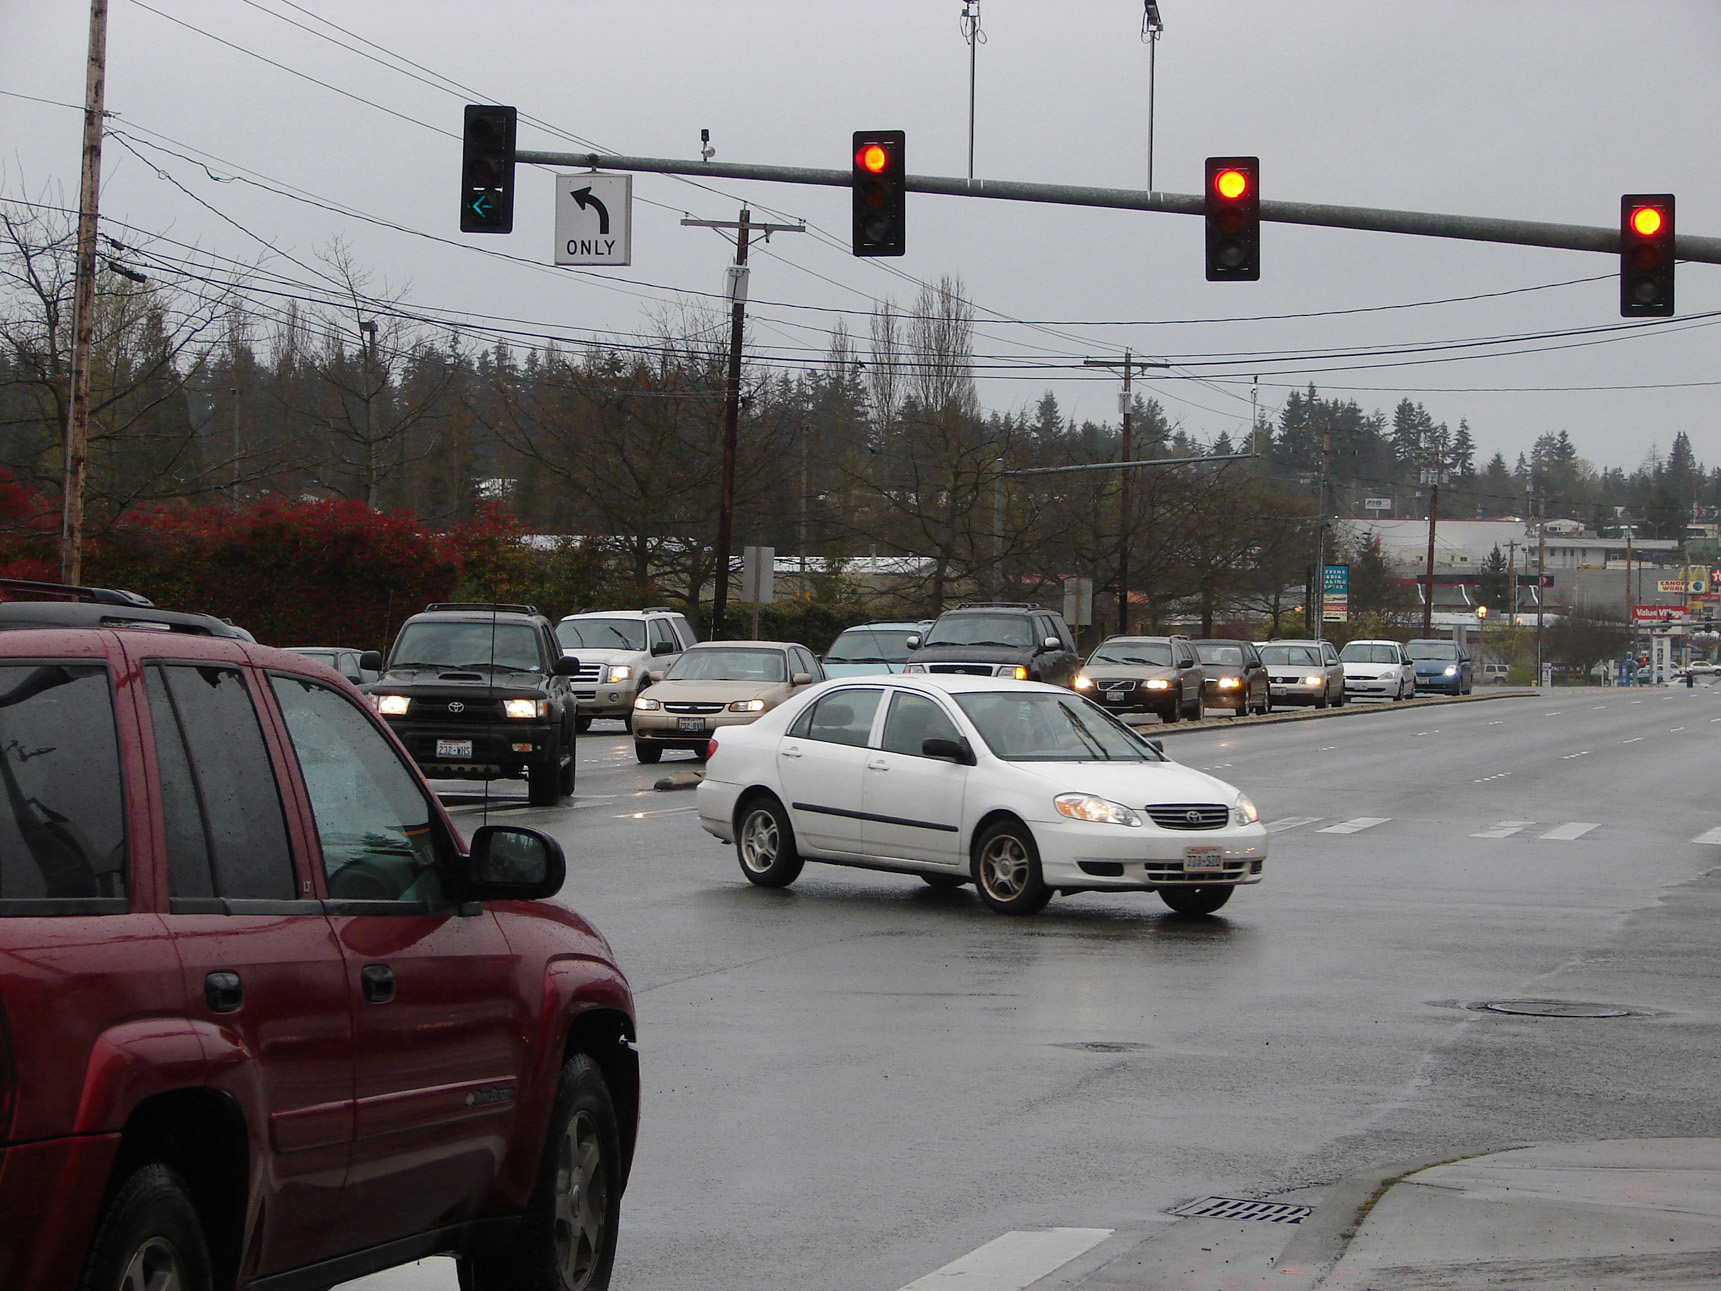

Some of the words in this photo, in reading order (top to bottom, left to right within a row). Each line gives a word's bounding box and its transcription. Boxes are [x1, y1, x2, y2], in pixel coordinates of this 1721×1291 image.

[566, 239, 616, 255] ONLY
[1636, 608, 1657, 617] Value
[303, 880, 311, 892] LT
